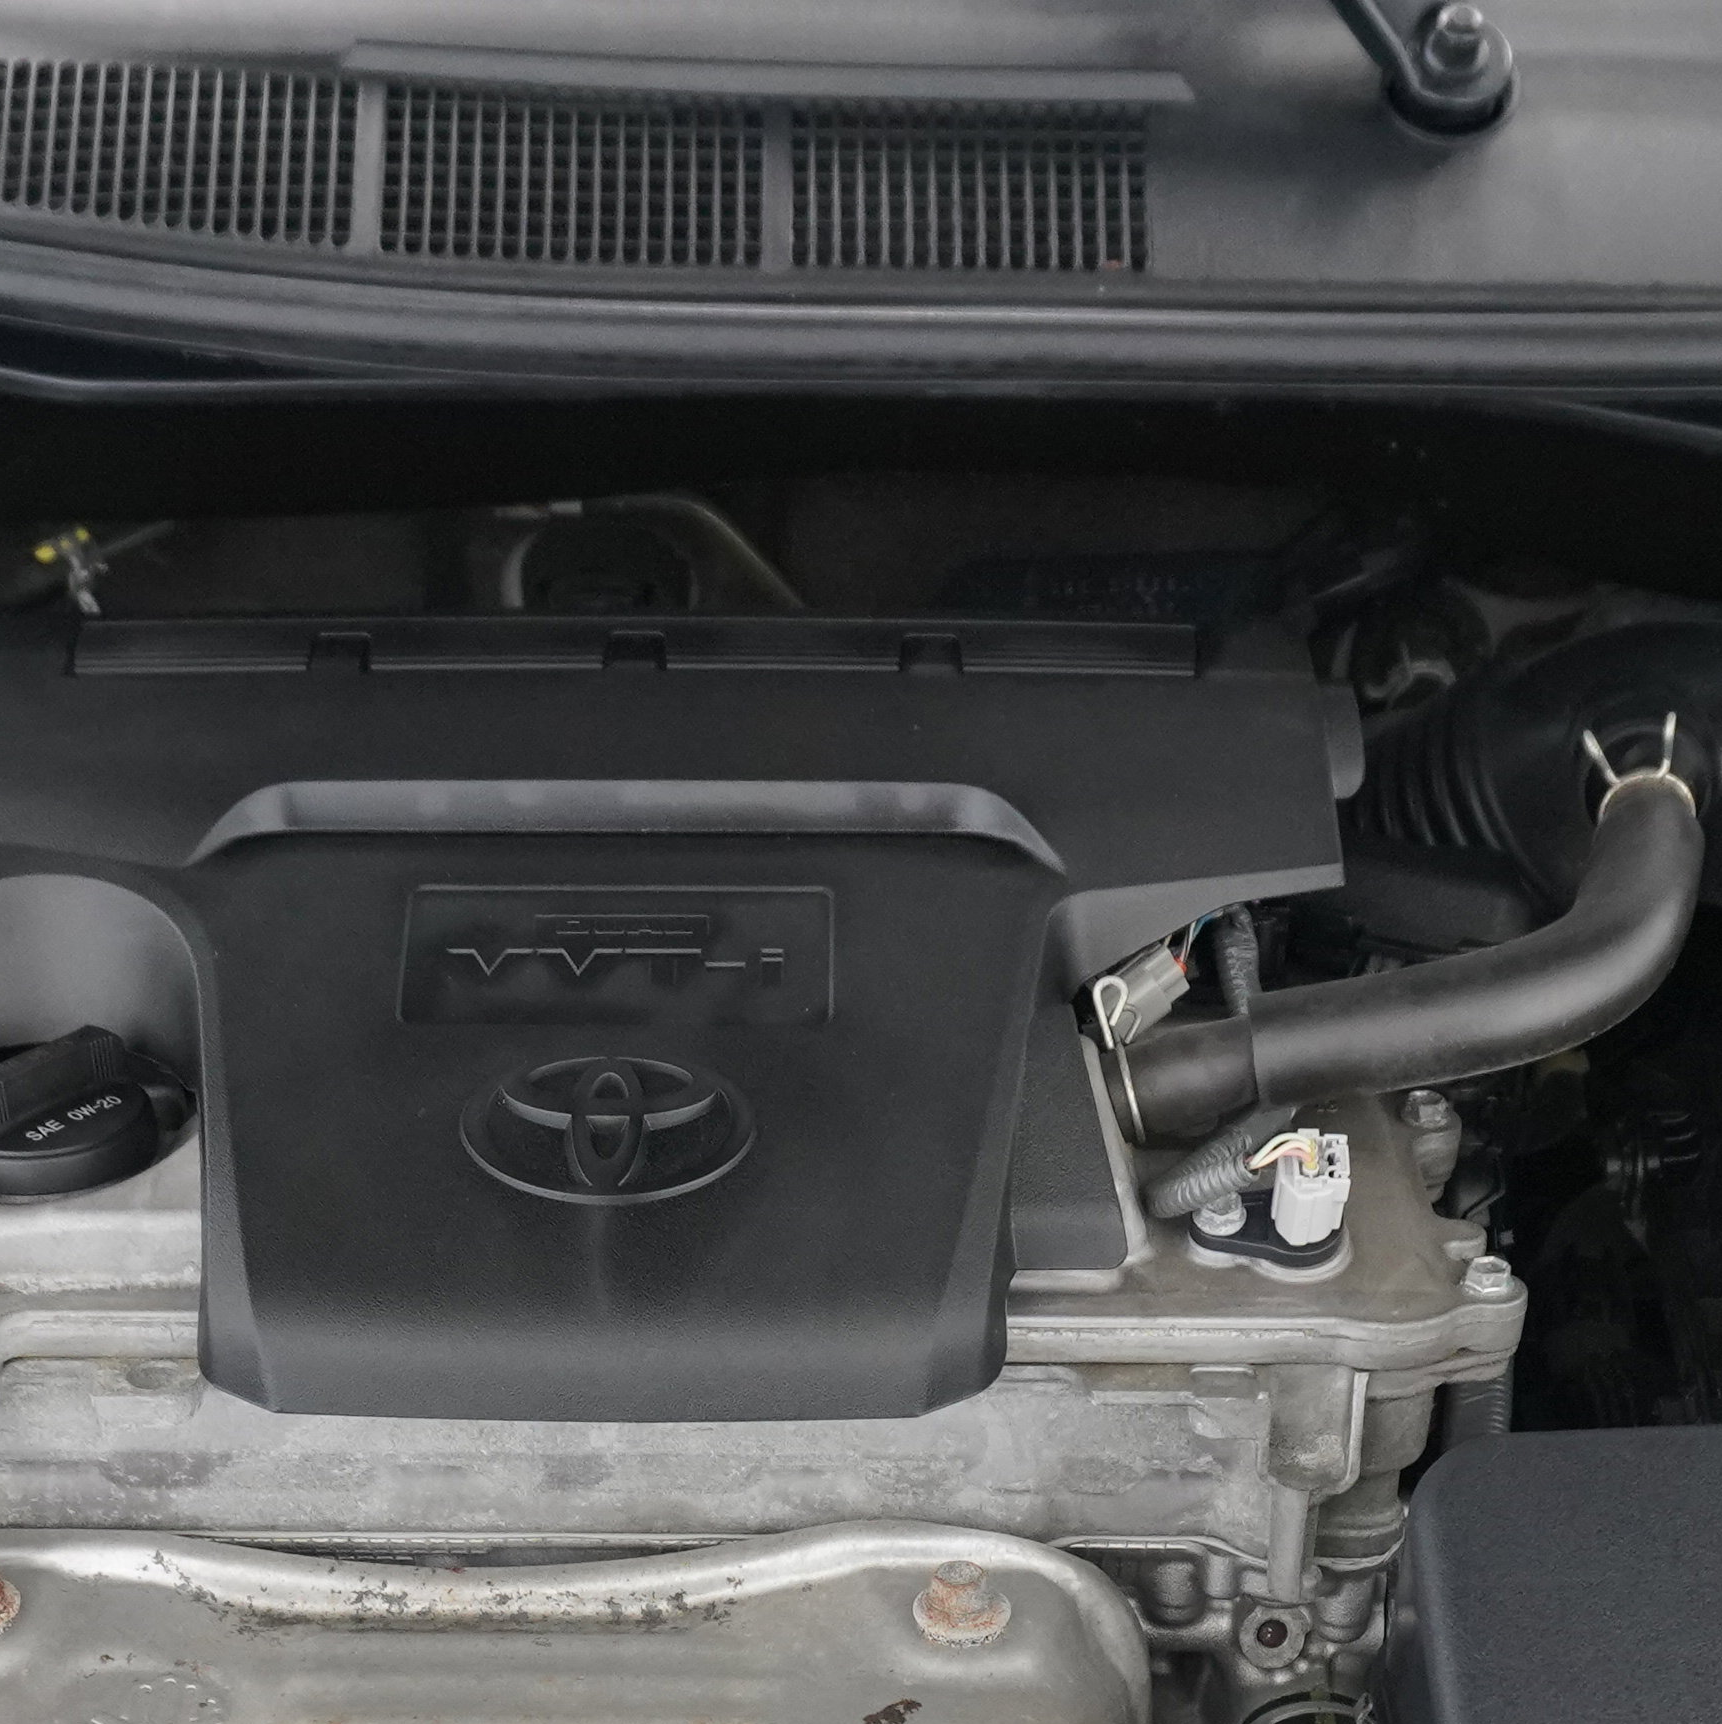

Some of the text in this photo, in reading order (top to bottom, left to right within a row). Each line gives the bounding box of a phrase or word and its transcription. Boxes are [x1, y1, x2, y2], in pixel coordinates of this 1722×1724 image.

[445, 947, 786, 989] VVT-i
[25, 1095, 123, 1142] SAE 0W-20
